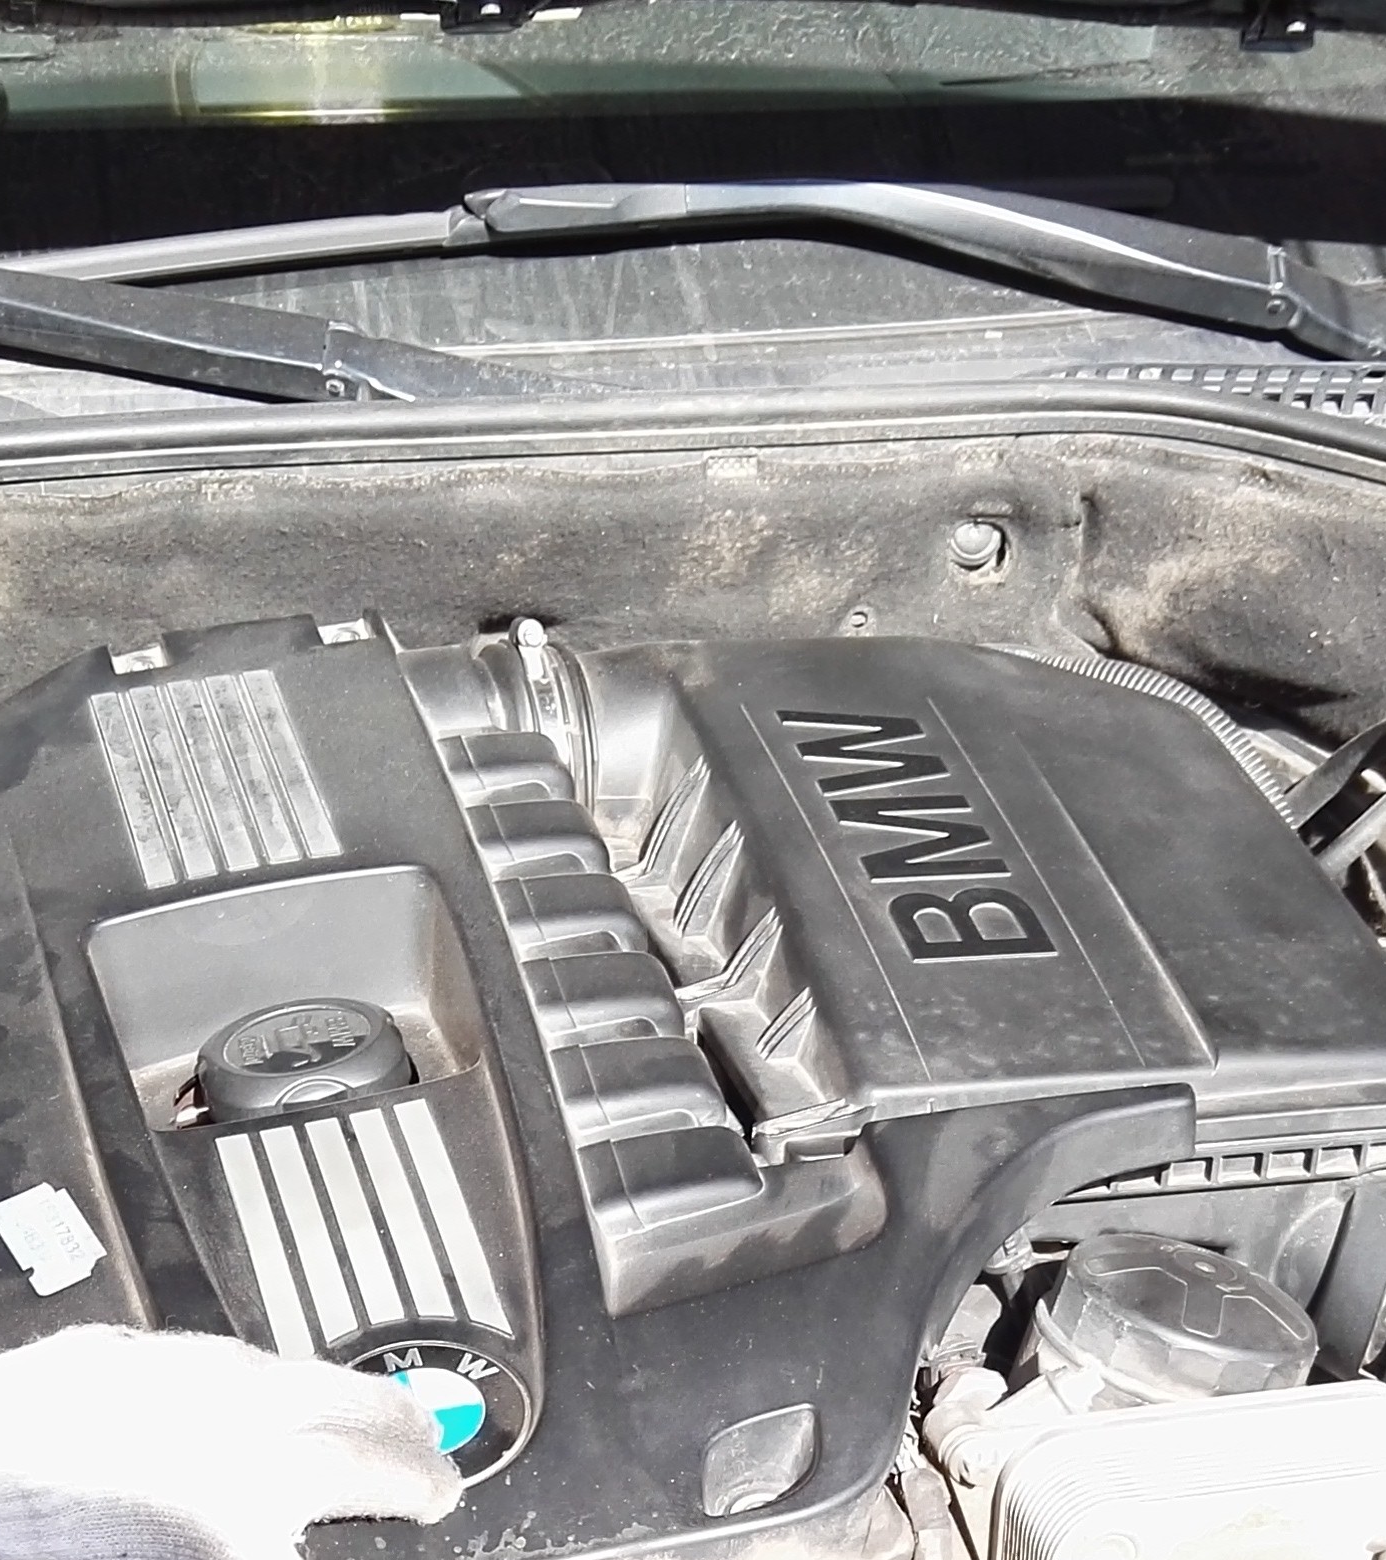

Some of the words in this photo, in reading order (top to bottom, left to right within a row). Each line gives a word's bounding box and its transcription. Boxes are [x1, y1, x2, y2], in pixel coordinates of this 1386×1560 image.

[774, 709, 1059, 964] BMW
[326, 1014, 356, 1048] BMW
[382, 1347, 500, 1380] MW
